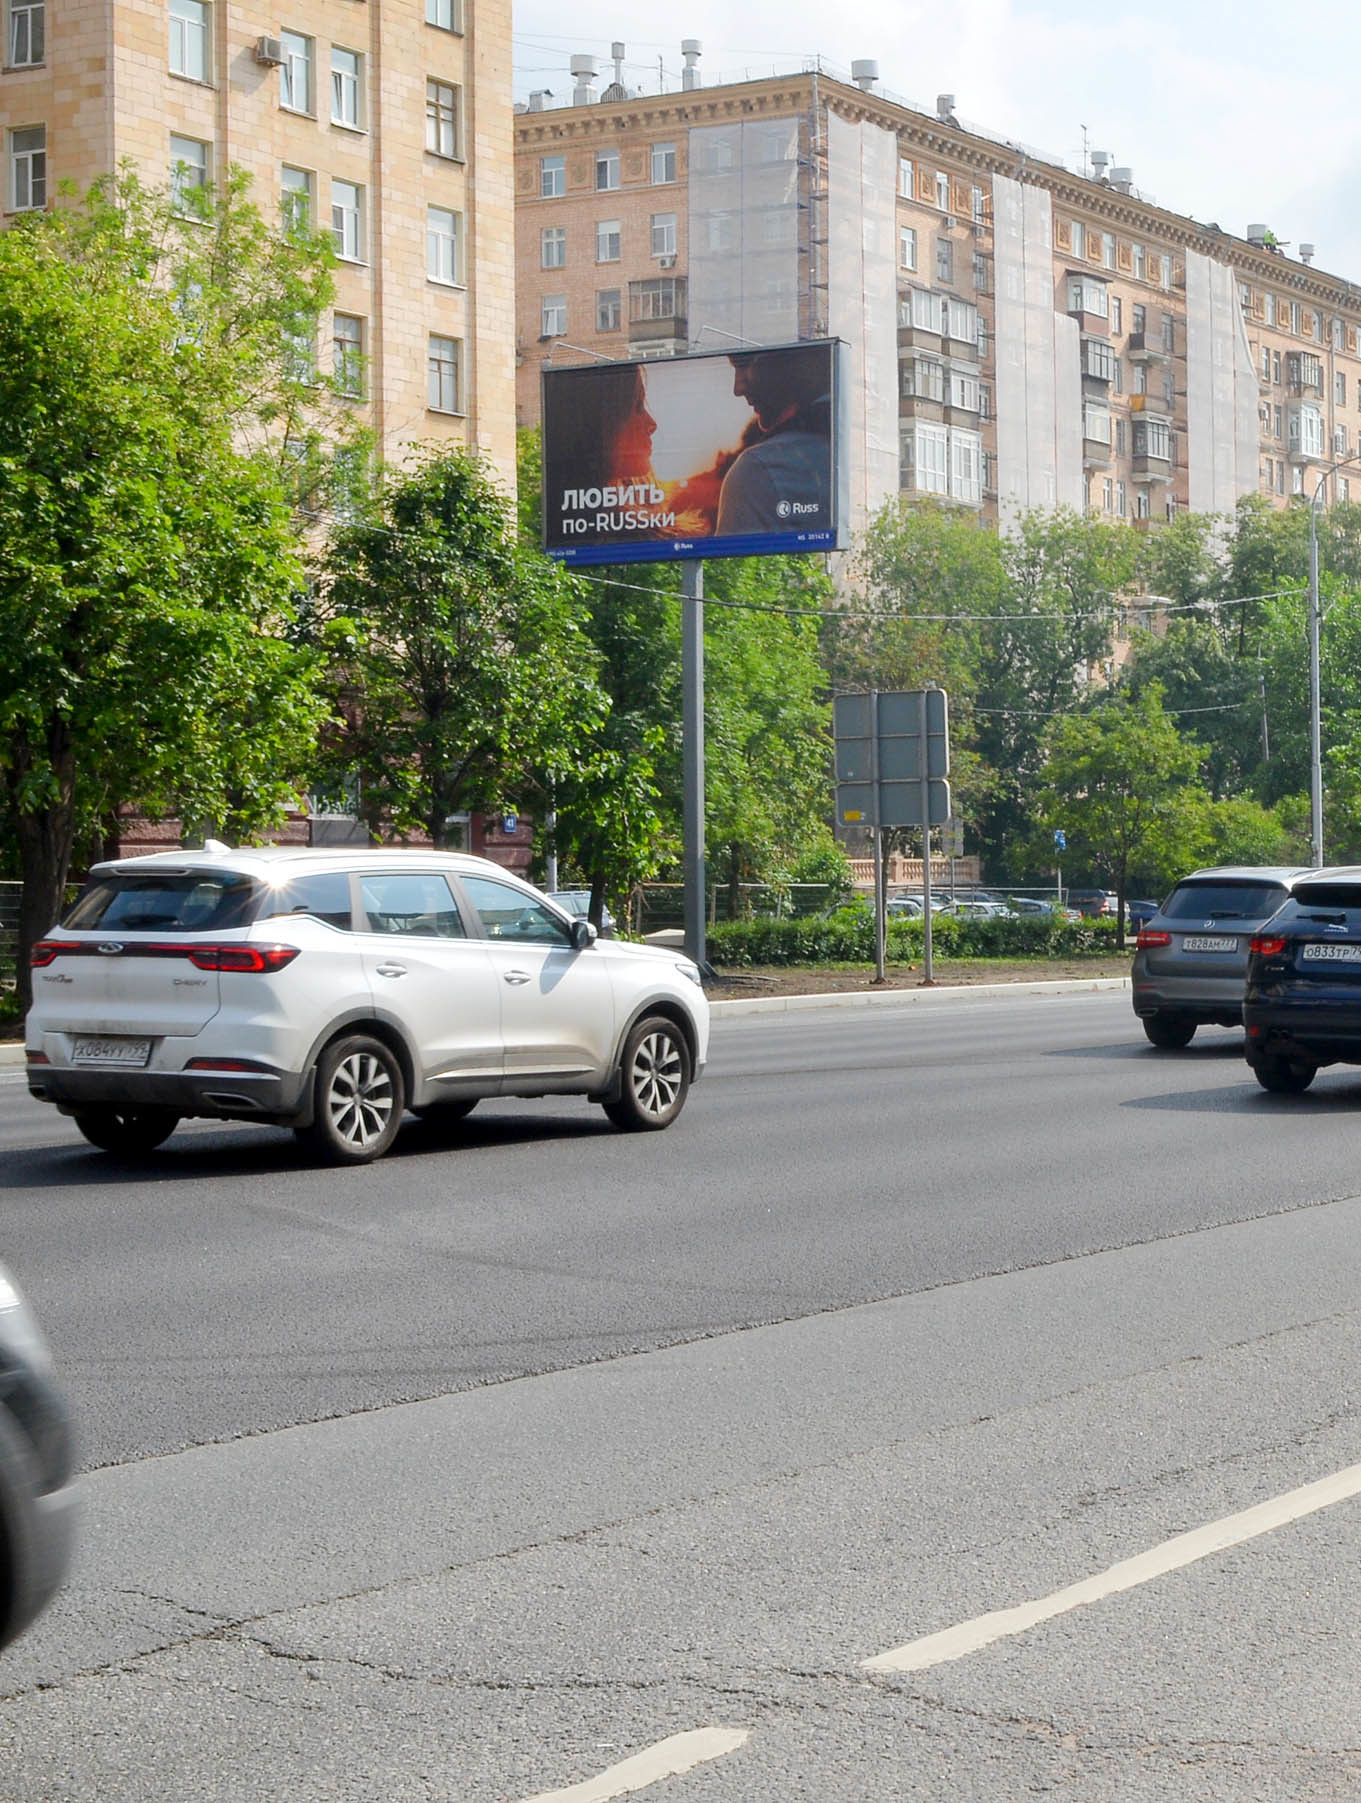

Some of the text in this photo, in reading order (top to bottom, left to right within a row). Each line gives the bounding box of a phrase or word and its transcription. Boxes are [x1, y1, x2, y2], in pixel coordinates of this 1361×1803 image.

[561, 482, 665, 511] ЛЮБИТЬ
[793, 502, 819, 514] Russ
[562, 510, 675, 534] по-RUSSки
